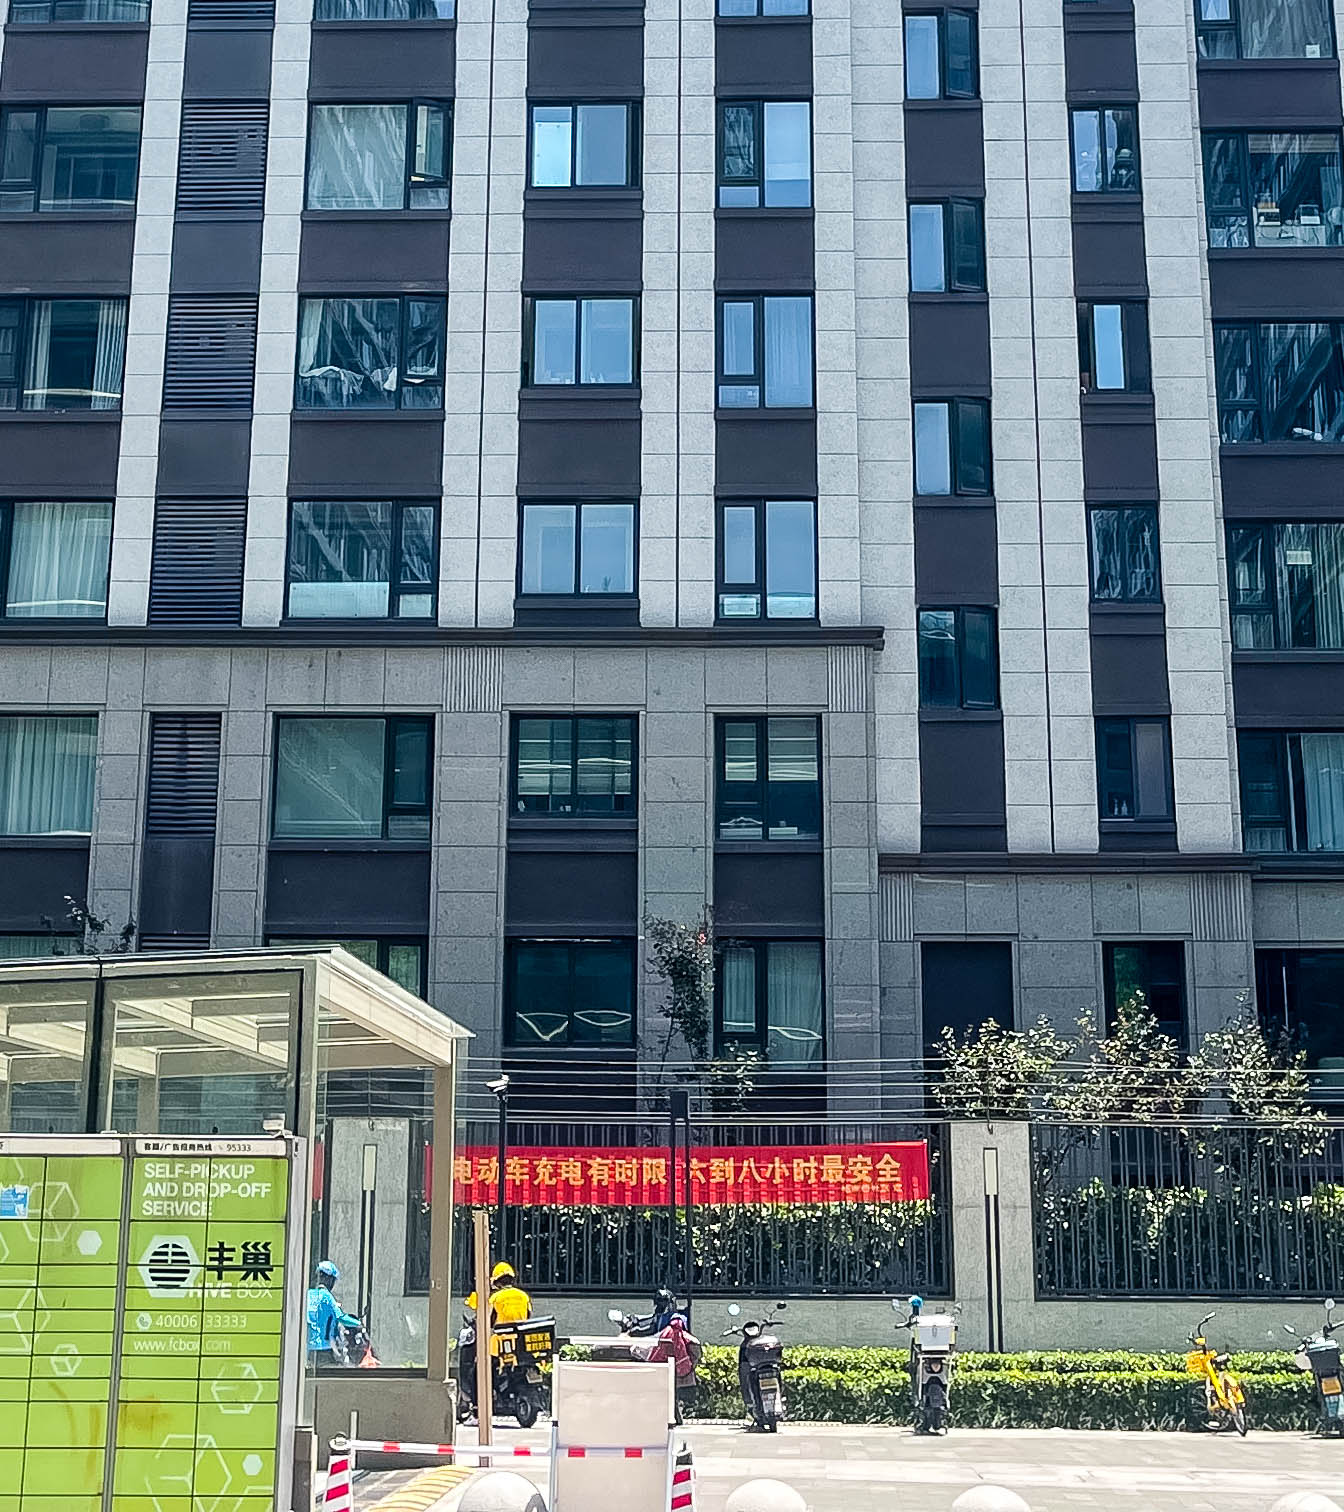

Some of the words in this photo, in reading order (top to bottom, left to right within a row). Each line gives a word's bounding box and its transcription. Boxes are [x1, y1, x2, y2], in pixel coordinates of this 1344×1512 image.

[226, 1143, 252, 1152] 95333
[144, 1163, 255, 1179] SELF-PICKUP
[142, 1182, 179, 1197] AND
[182, 1182, 272, 1198] DROP-OFF
[141, 1200, 213, 1217] SERVICE
[206, 1240, 274, 1281] 丰巢
[188, 1281, 232, 1299] HIVE
[236, 1281, 273, 1299] BOX
